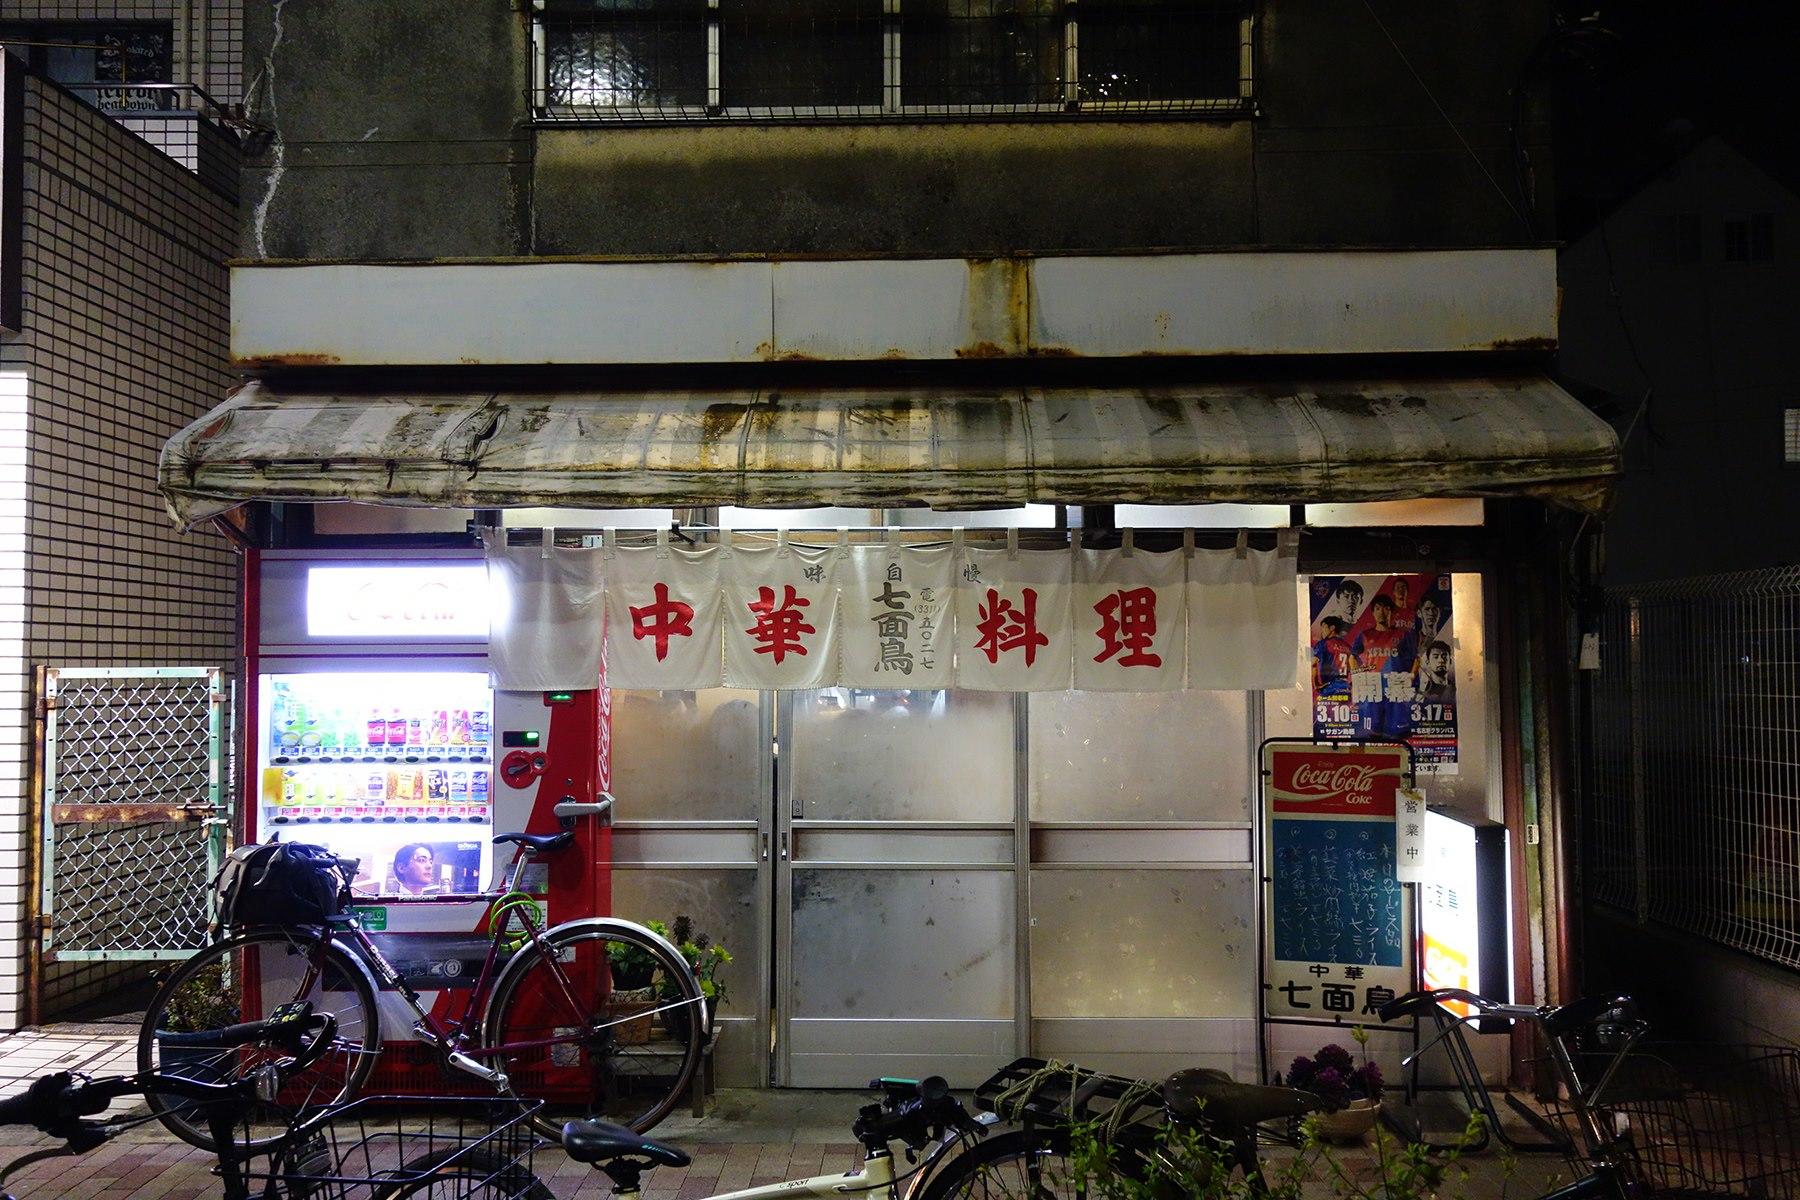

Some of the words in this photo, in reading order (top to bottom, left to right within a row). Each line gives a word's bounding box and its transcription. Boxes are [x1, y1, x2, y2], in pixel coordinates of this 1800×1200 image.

[871, 582, 915, 676] 七面鳥
[597, 636, 611, 792] Coca-C
[1317, 704, 1350, 723] 3.10
[1411, 703, 1442, 722] 3.17
[1292, 763, 1377, 792] Coca-Cola
[1345, 792, 1373, 805] Coke
[1404, 799, 1420, 860] 営業中
[1309, 964, 1365, 981] 中華
[1278, 980, 1395, 1015] 七面鳥
